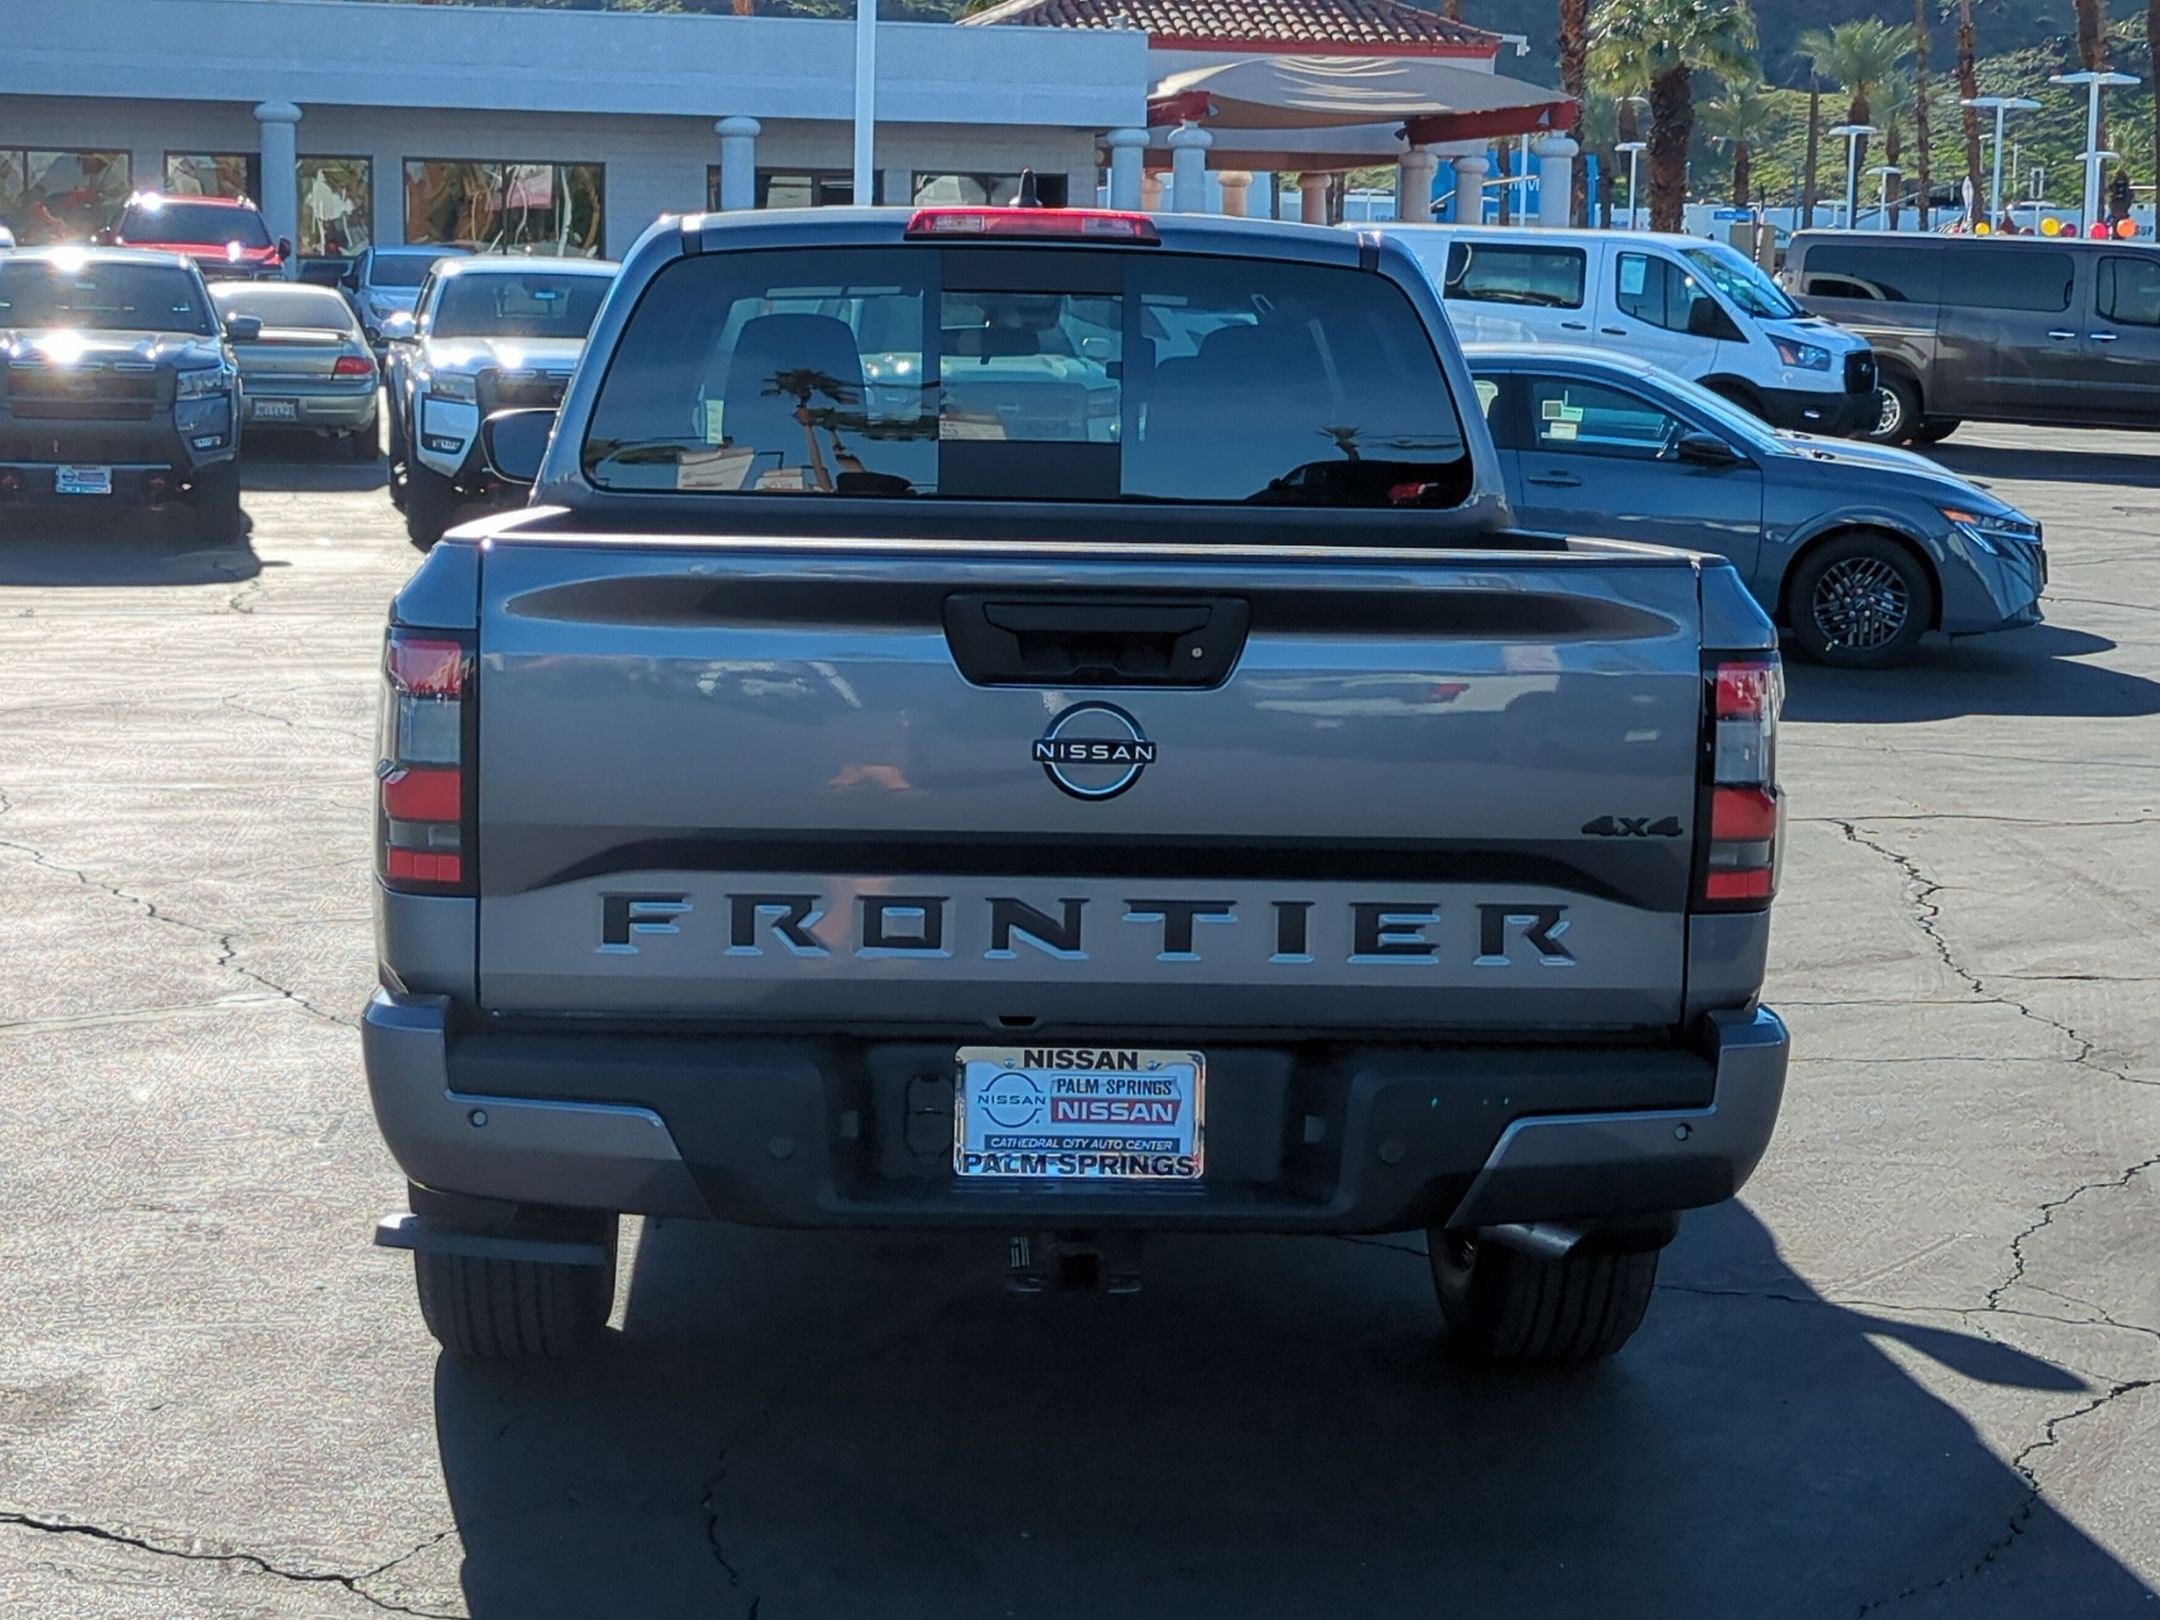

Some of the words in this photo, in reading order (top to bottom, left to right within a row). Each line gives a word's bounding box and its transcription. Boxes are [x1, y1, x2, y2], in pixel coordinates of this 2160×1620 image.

[1036, 743, 1153, 760] NISSAN
[596, 893, 1577, 967] FRONTIER
[1023, 1050, 1139, 1070] NISSAN
[1056, 1078, 1099, 1095] PALM
[1106, 1079, 1172, 1096] SPRINGS
[977, 1094, 1046, 1106] NISSAN
[1057, 1101, 1173, 1122] NISSAN
[990, 1137, 1060, 1149] CATHEDRAL
[1062, 1138, 1088, 1149] CITY
[1091, 1139, 1122, 1150] AUTO
[1125, 1139, 1173, 1151] CENTER
[962, 1153, 1047, 1174] PALM
[1057, 1153, 1194, 1176] SPRINGS
